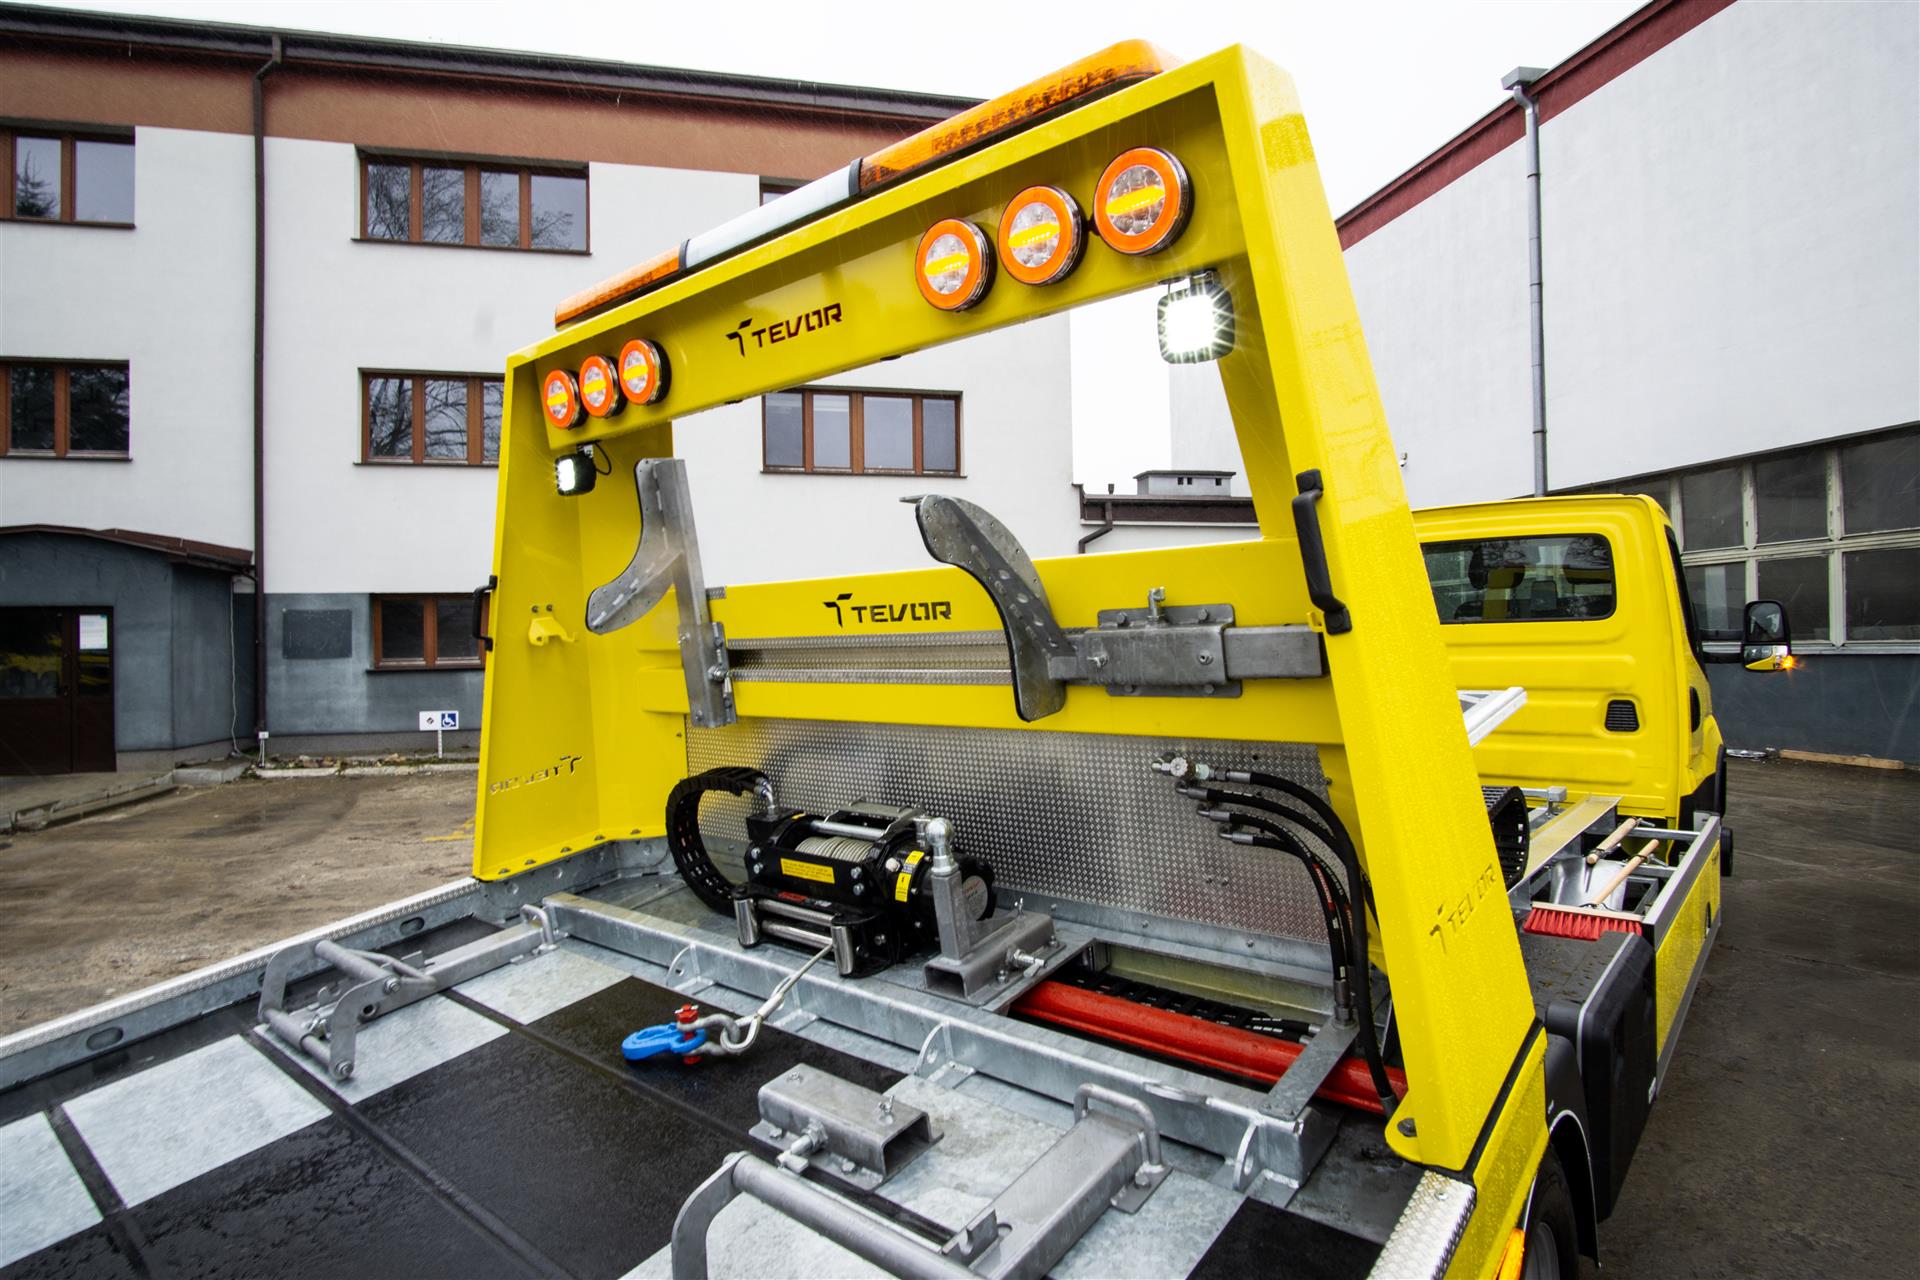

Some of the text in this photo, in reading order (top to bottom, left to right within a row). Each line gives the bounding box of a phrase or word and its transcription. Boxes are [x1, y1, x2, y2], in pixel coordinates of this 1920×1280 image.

[752, 303, 842, 348] TEVOR
[851, 601, 951, 623] TEVOR
[1447, 864, 1496, 933] TEVOR
